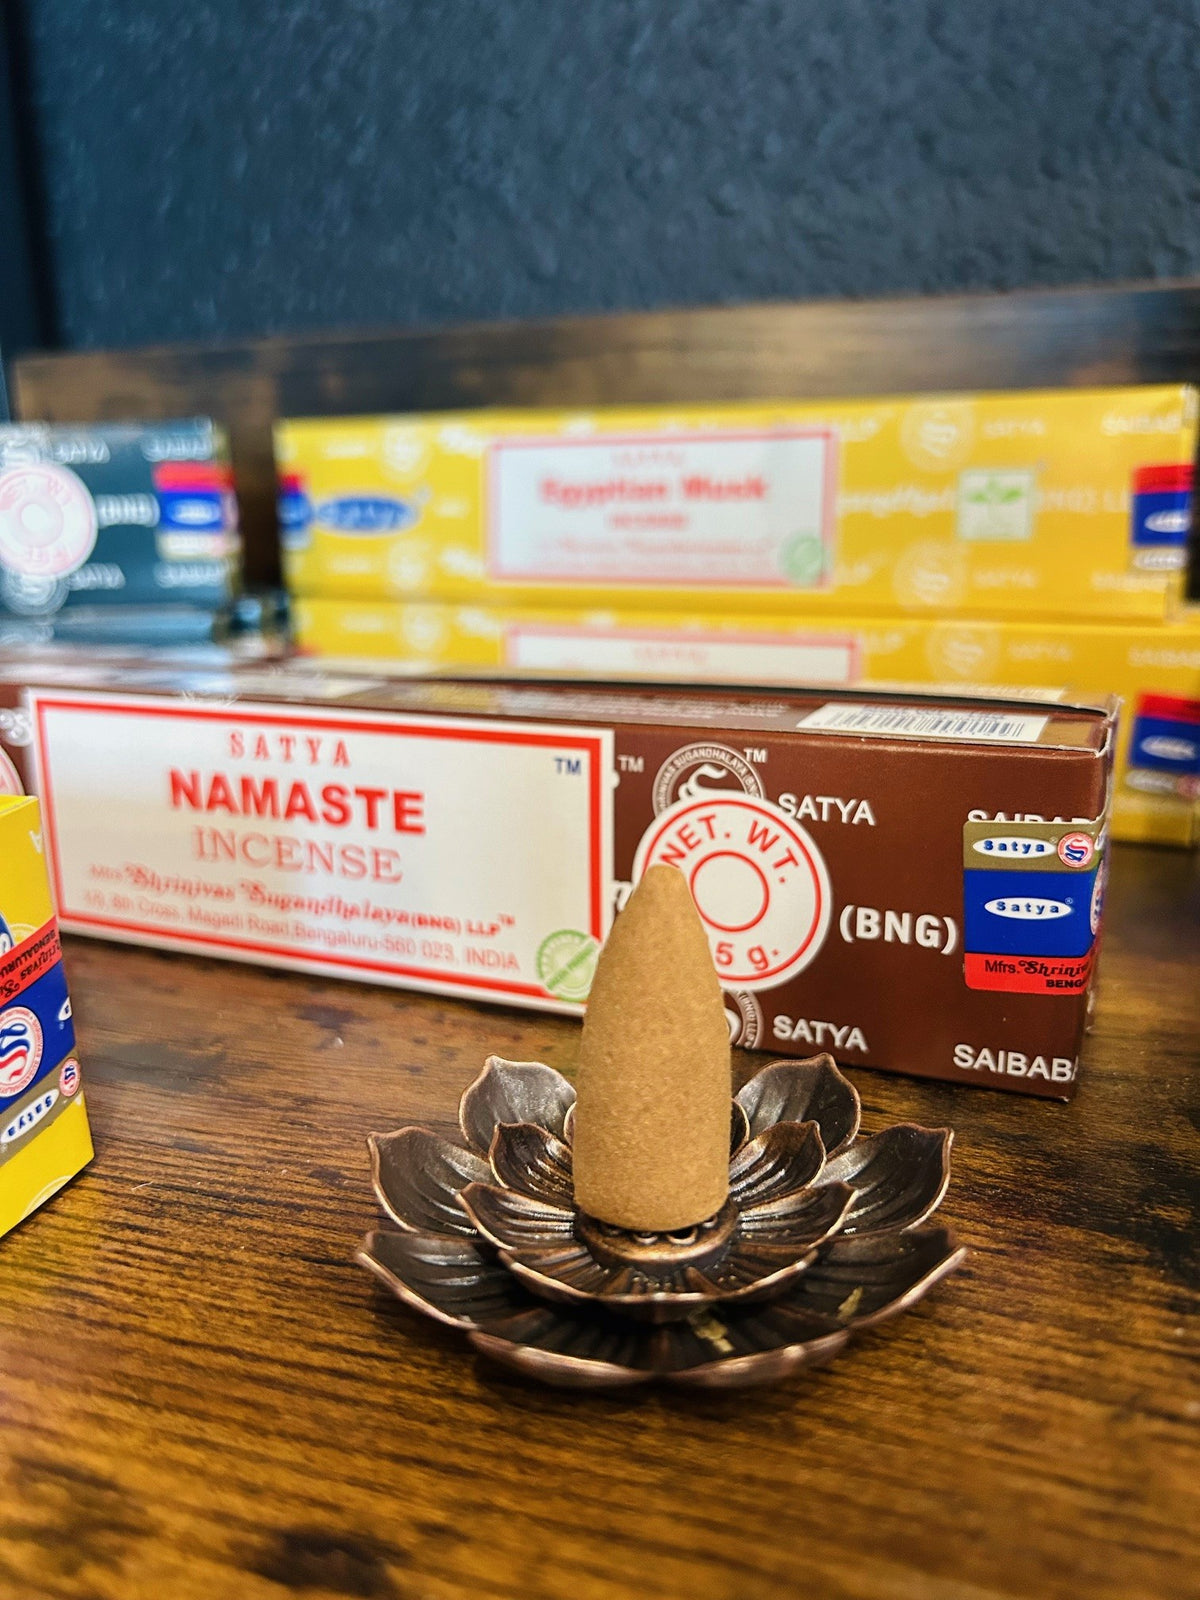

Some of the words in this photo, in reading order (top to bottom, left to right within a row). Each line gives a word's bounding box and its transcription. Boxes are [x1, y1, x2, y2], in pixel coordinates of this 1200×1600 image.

[229, 730, 352, 768] SATYA
[743, 746, 768, 764] TM
[554, 757, 582, 776] TM
[617, 754, 645, 775] TM
[168, 768, 427, 837] NAMASTE
[777, 793, 877, 827] SATYA
[193, 824, 404, 885] INCENSE
[983, 840, 1045, 854] Satya
[996, 900, 1060, 915] Satya
[839, 904, 957, 955] (BNG)
[464, 944, 521, 974] INDIA
[984, 958, 1020, 975] Mfrs.
[773, 1014, 869, 1054] SATYA
